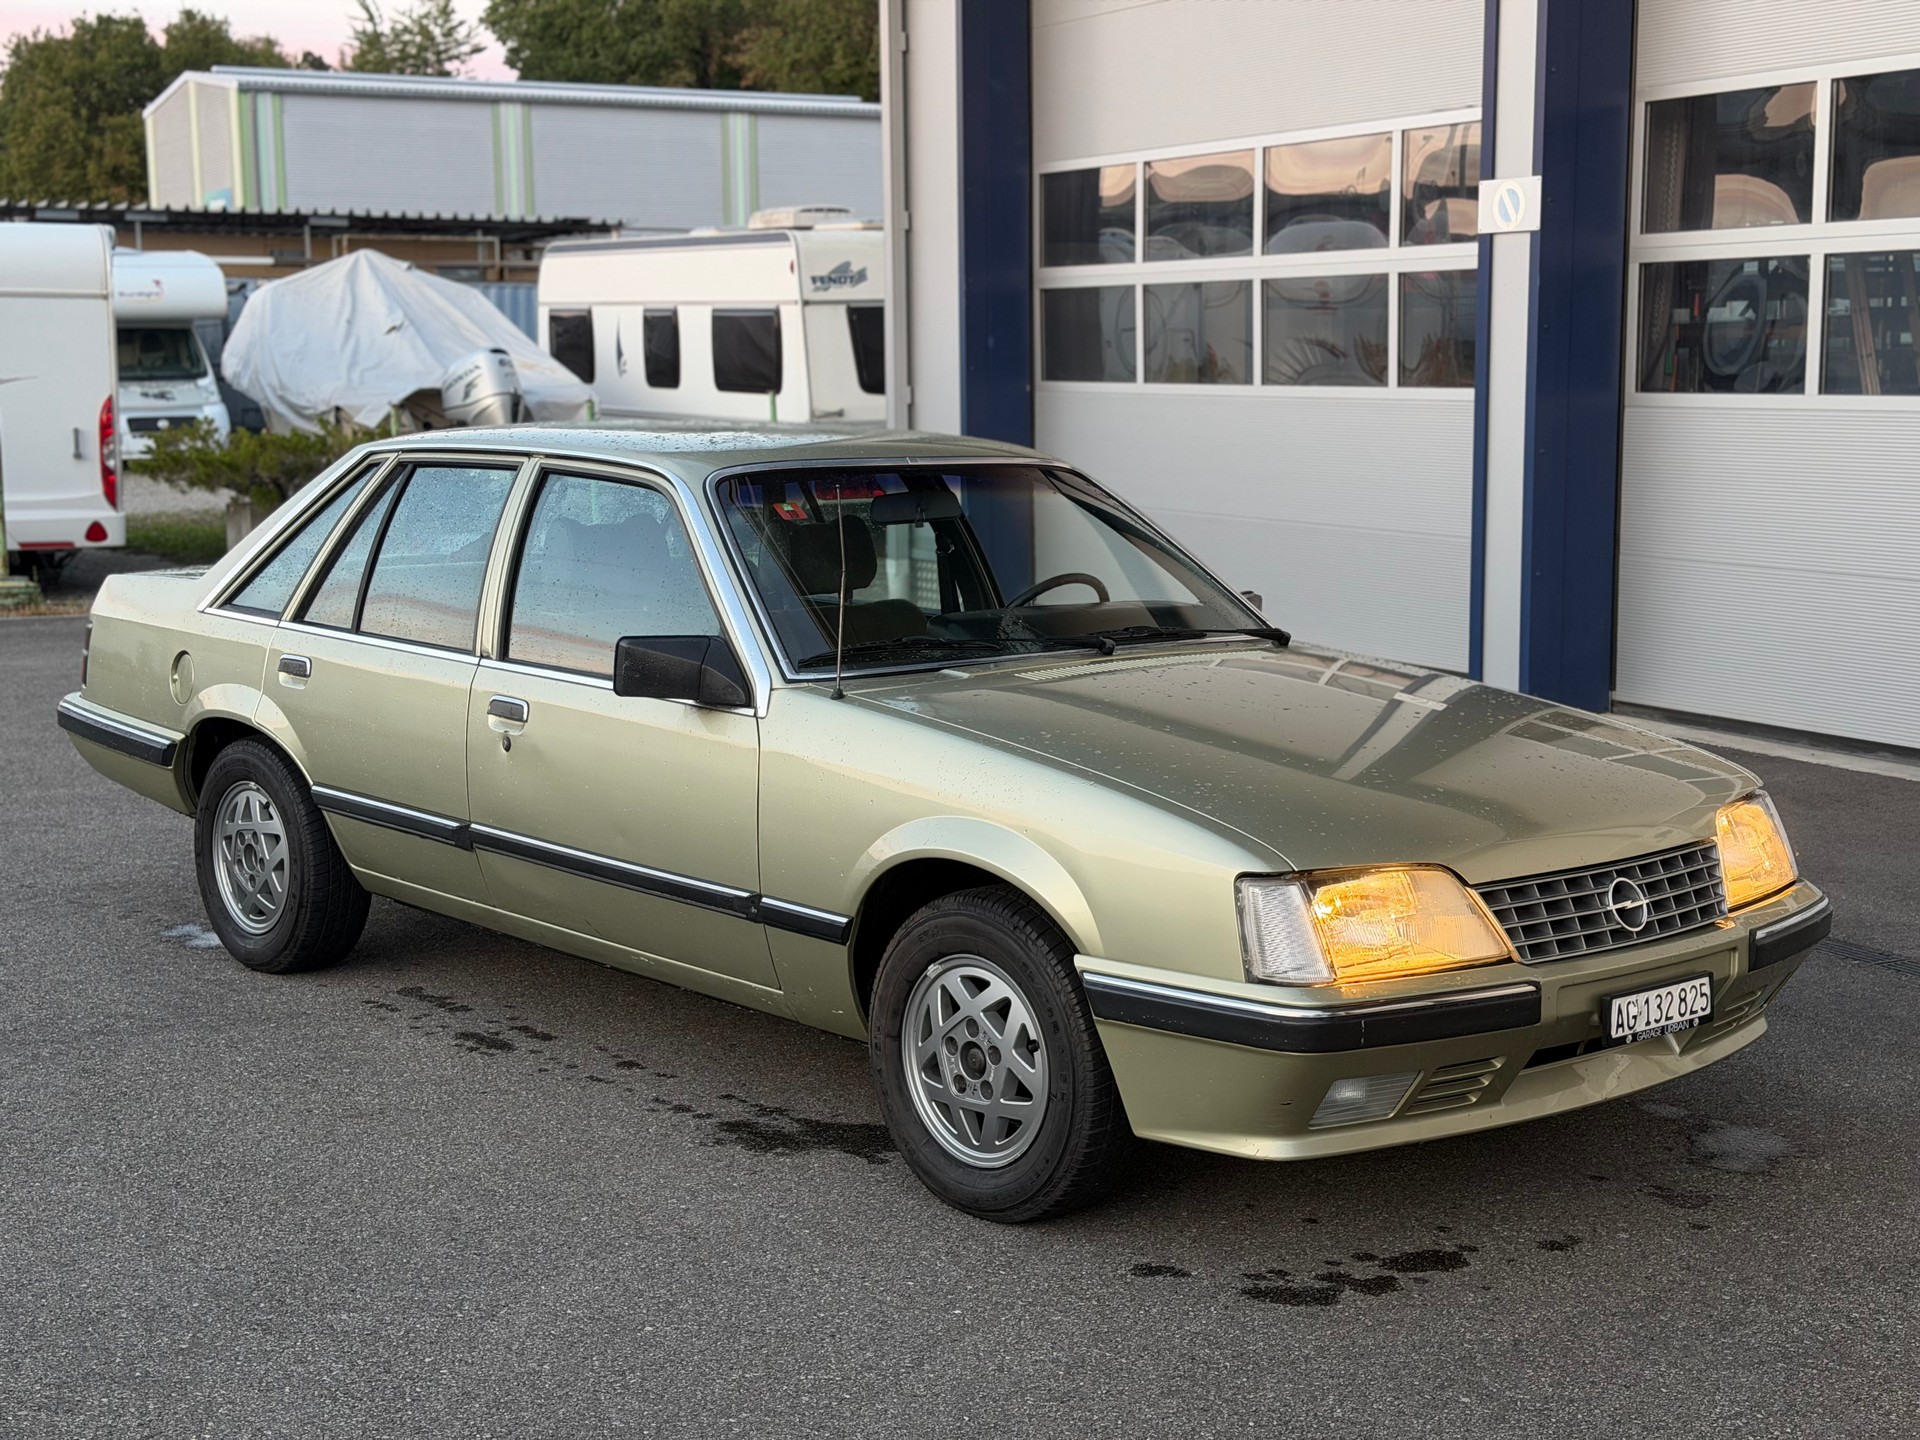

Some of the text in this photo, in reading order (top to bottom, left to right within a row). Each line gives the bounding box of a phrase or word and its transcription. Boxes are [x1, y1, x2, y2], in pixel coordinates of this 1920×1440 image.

[811, 275, 855, 286] FENDT
[1643, 991, 1674, 1027] 132
[1678, 982, 1709, 1018] 825
[1636, 1020, 1689, 1041] GARAGE URBAN
